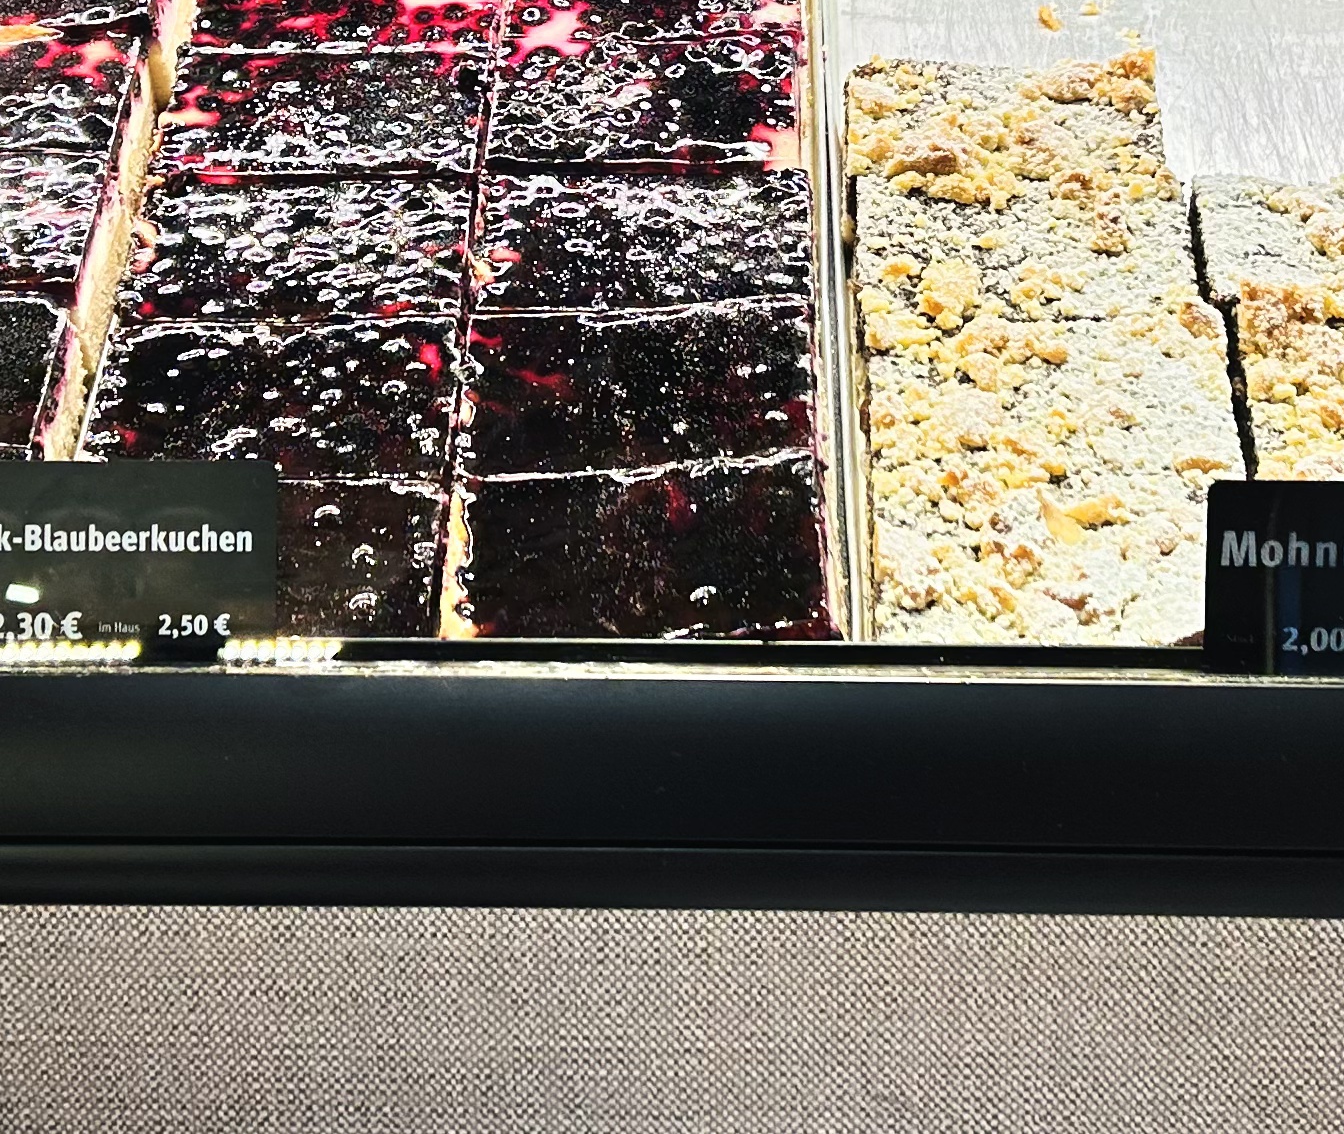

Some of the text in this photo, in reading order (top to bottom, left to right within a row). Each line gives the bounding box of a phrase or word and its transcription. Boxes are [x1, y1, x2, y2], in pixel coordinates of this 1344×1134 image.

[60, 611, 83, 640] €
[98, 621, 112, 633] im
[115, 621, 141, 634] Haus
[159, 614, 208, 639] 2,50
[214, 613, 230, 636] €
